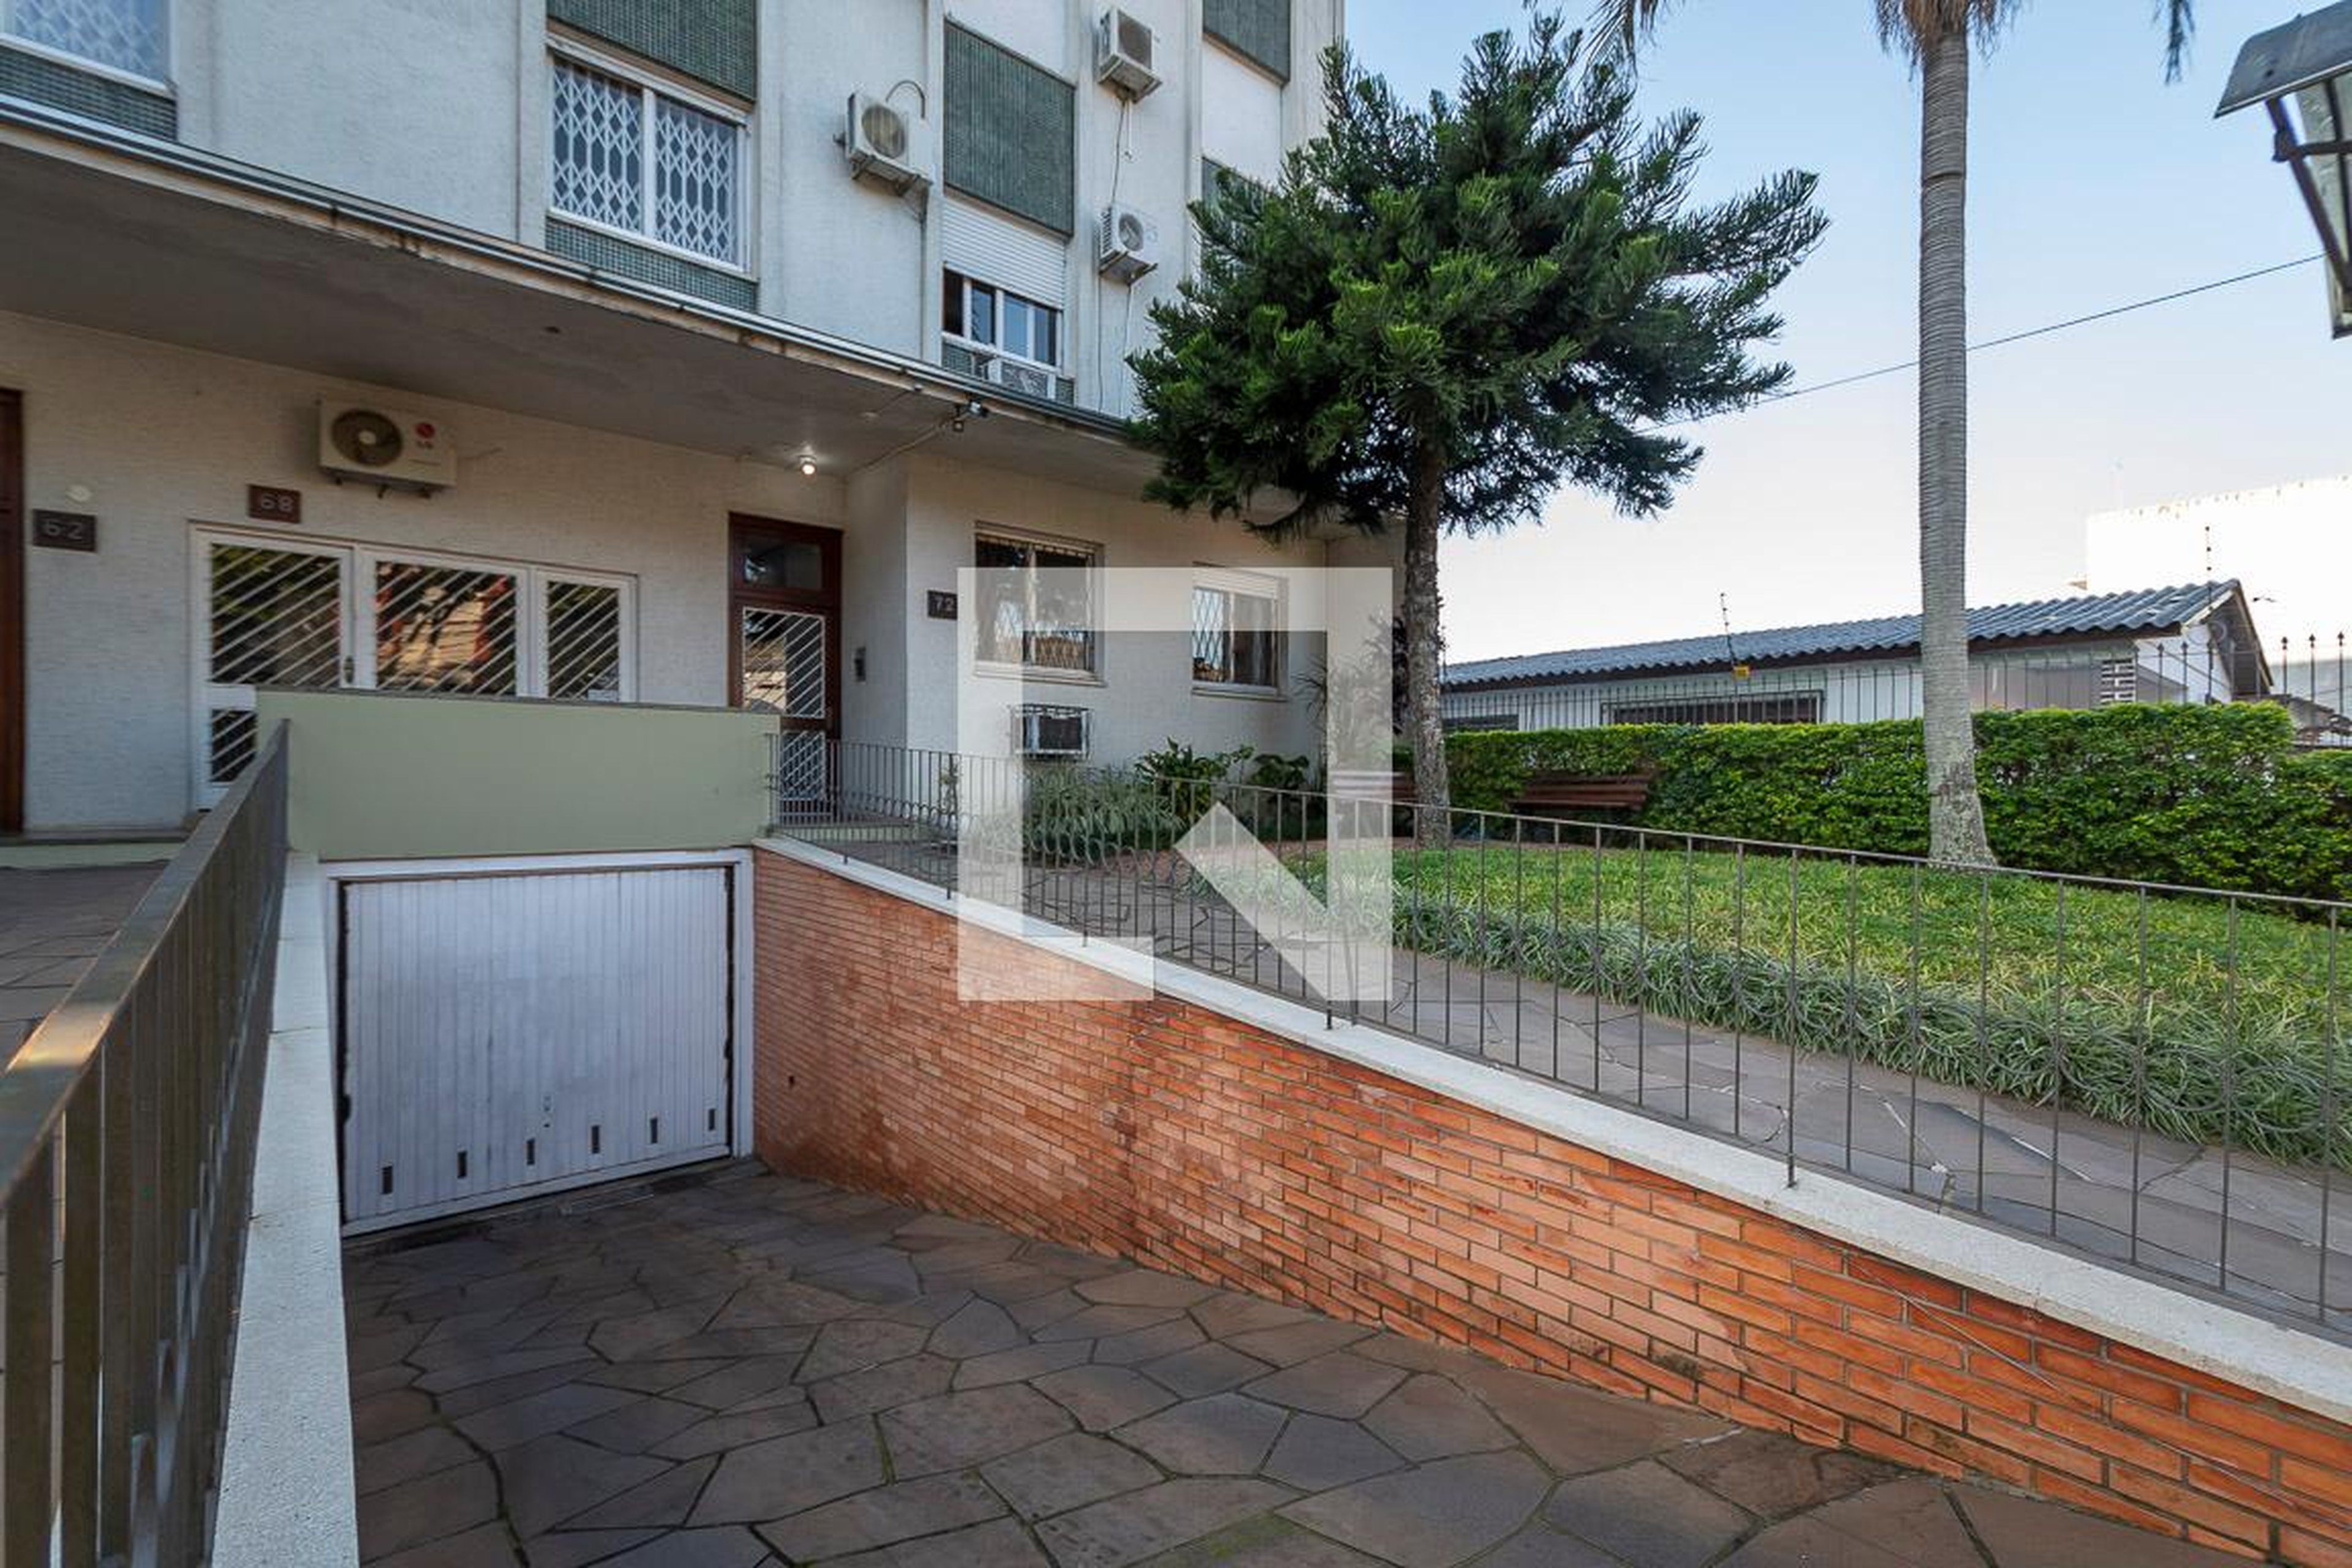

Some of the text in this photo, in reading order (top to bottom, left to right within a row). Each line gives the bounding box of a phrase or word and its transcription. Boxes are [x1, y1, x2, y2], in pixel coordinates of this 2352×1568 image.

[260, 493, 295, 513] 68
[45, 518, 84, 540] 62
[933, 595, 956, 611] 72
